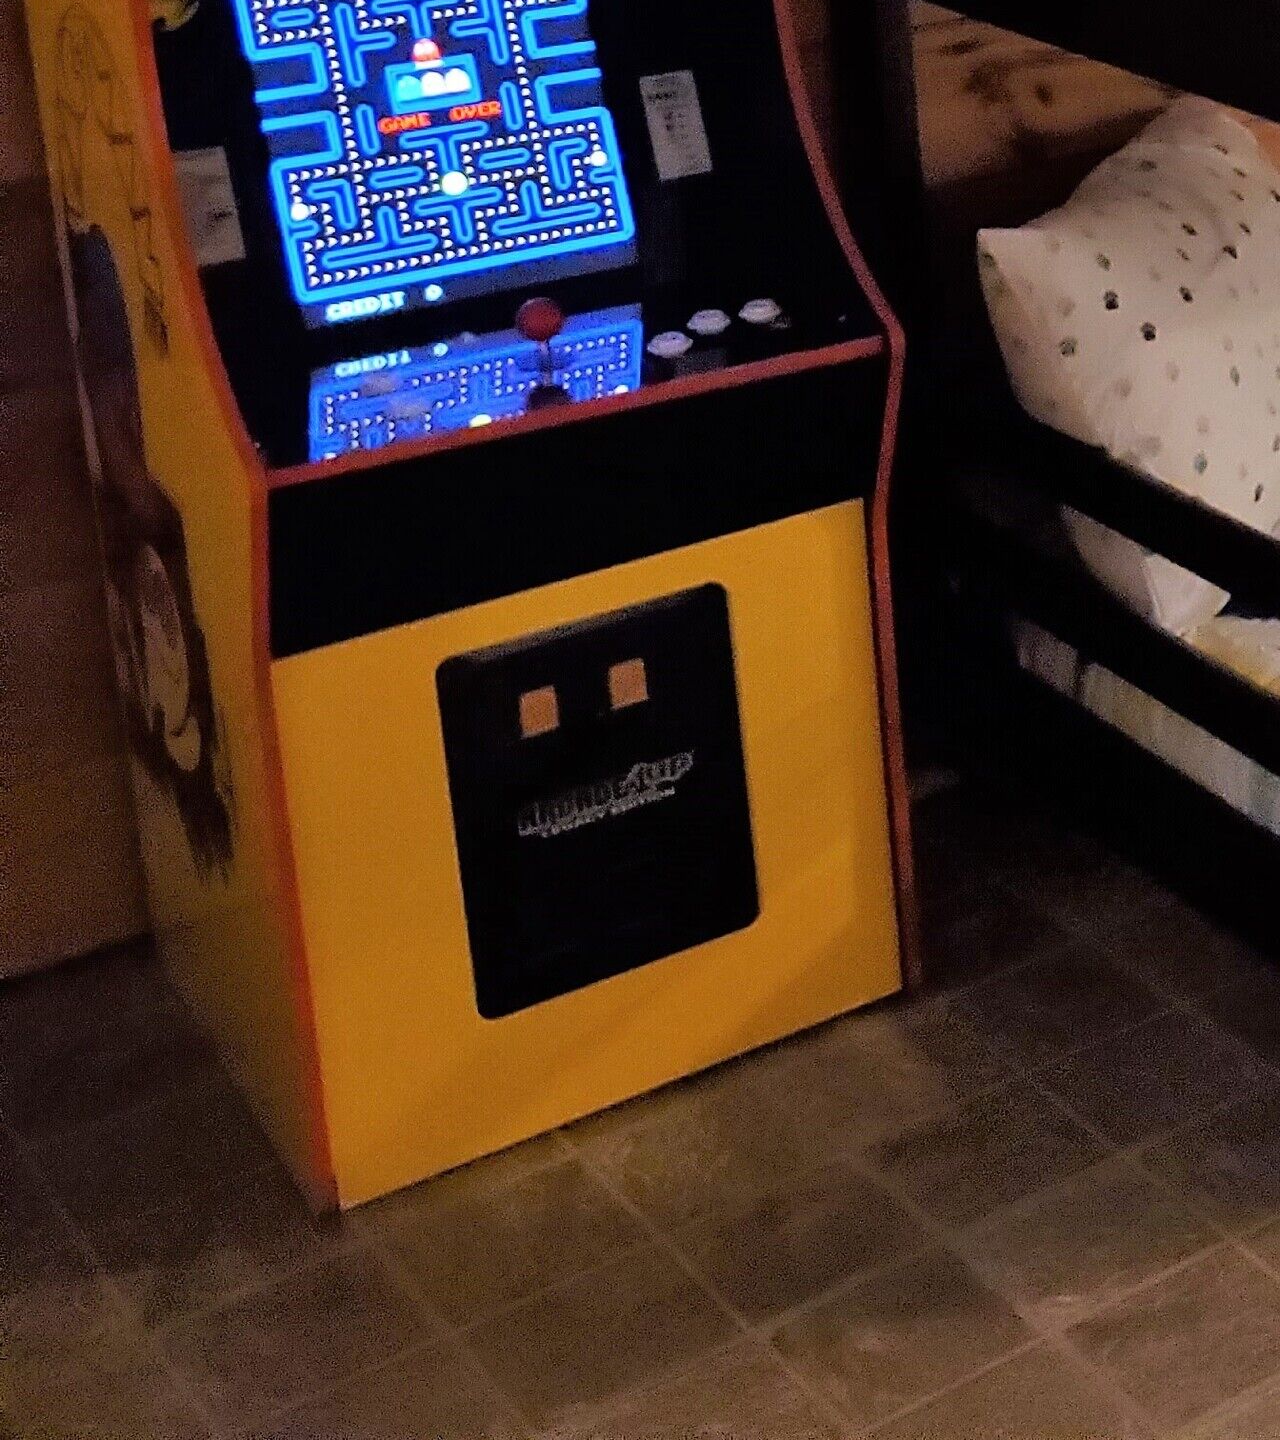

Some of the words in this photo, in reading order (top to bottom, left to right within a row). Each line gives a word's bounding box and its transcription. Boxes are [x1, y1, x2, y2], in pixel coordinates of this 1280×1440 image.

[377, 112, 432, 134] GAME
[448, 100, 502, 122] OVER
[325, 291, 405, 323] CREDIT
